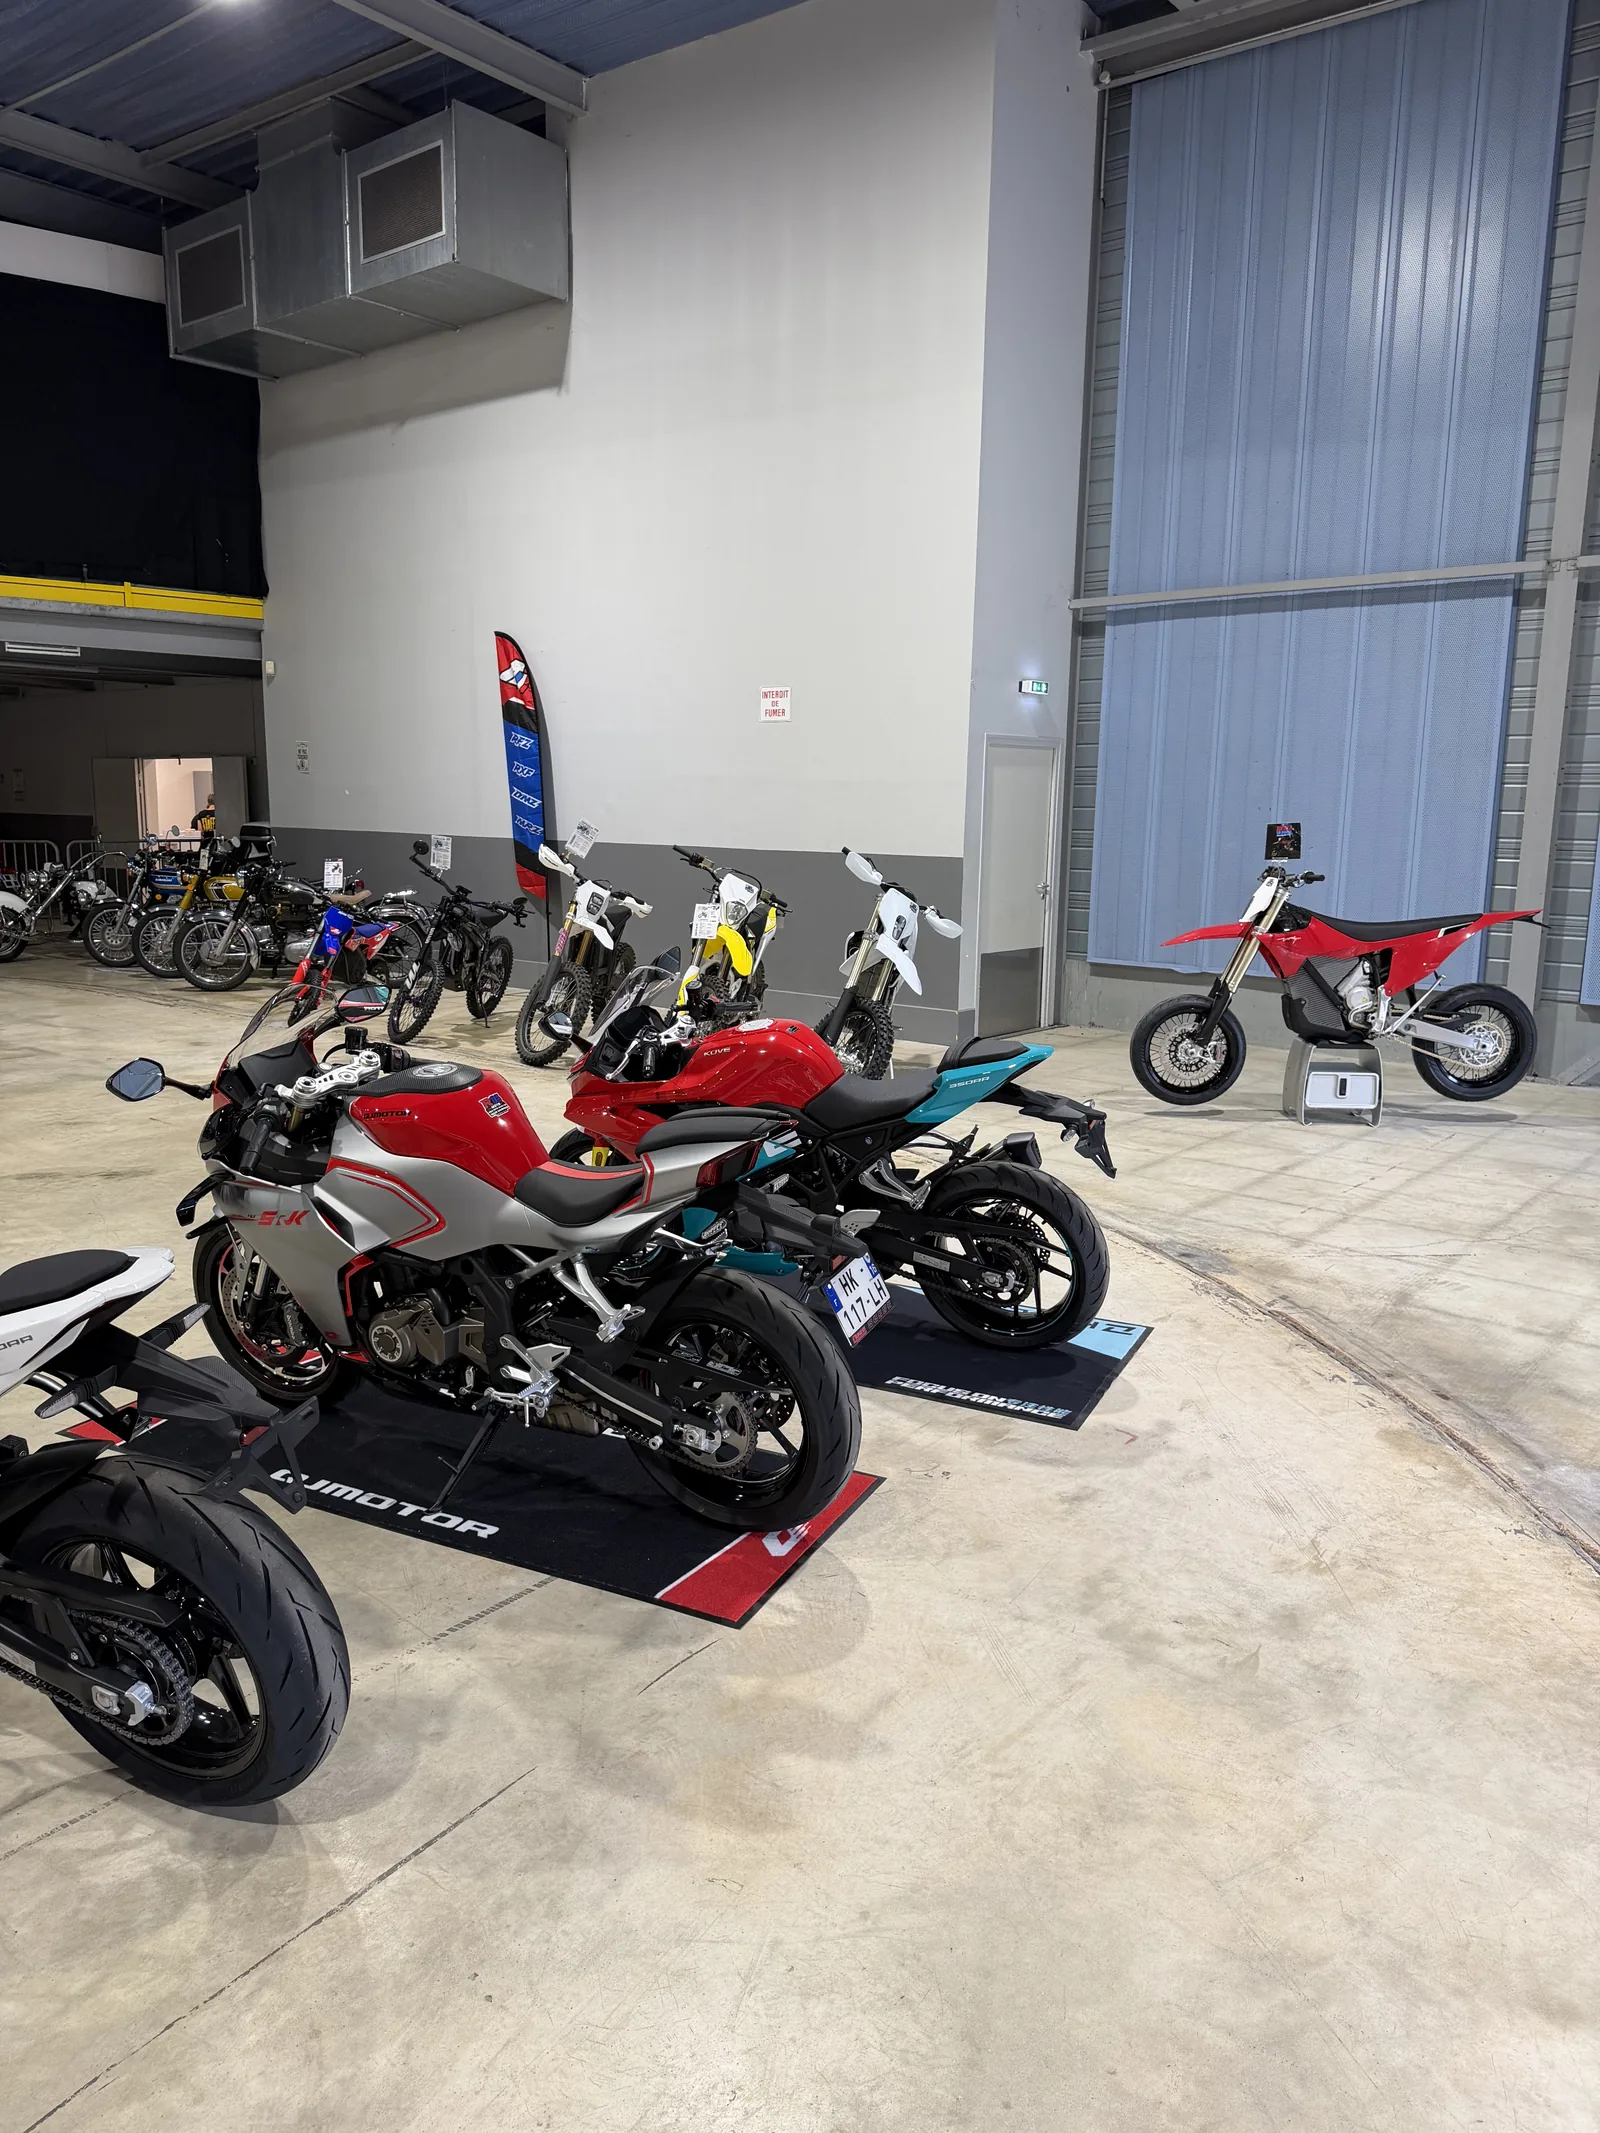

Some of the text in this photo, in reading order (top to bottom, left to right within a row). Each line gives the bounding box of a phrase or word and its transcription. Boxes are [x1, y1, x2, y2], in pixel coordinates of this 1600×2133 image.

[762, 690, 789, 699] INTERDIT
[765, 709, 786, 717] FUMER
[512, 760, 536, 778] RXF
[703, 1046, 731, 1057] KOVE
[838, 1268, 860, 1297] HK
[843, 1279, 887, 1330] 117-LH
